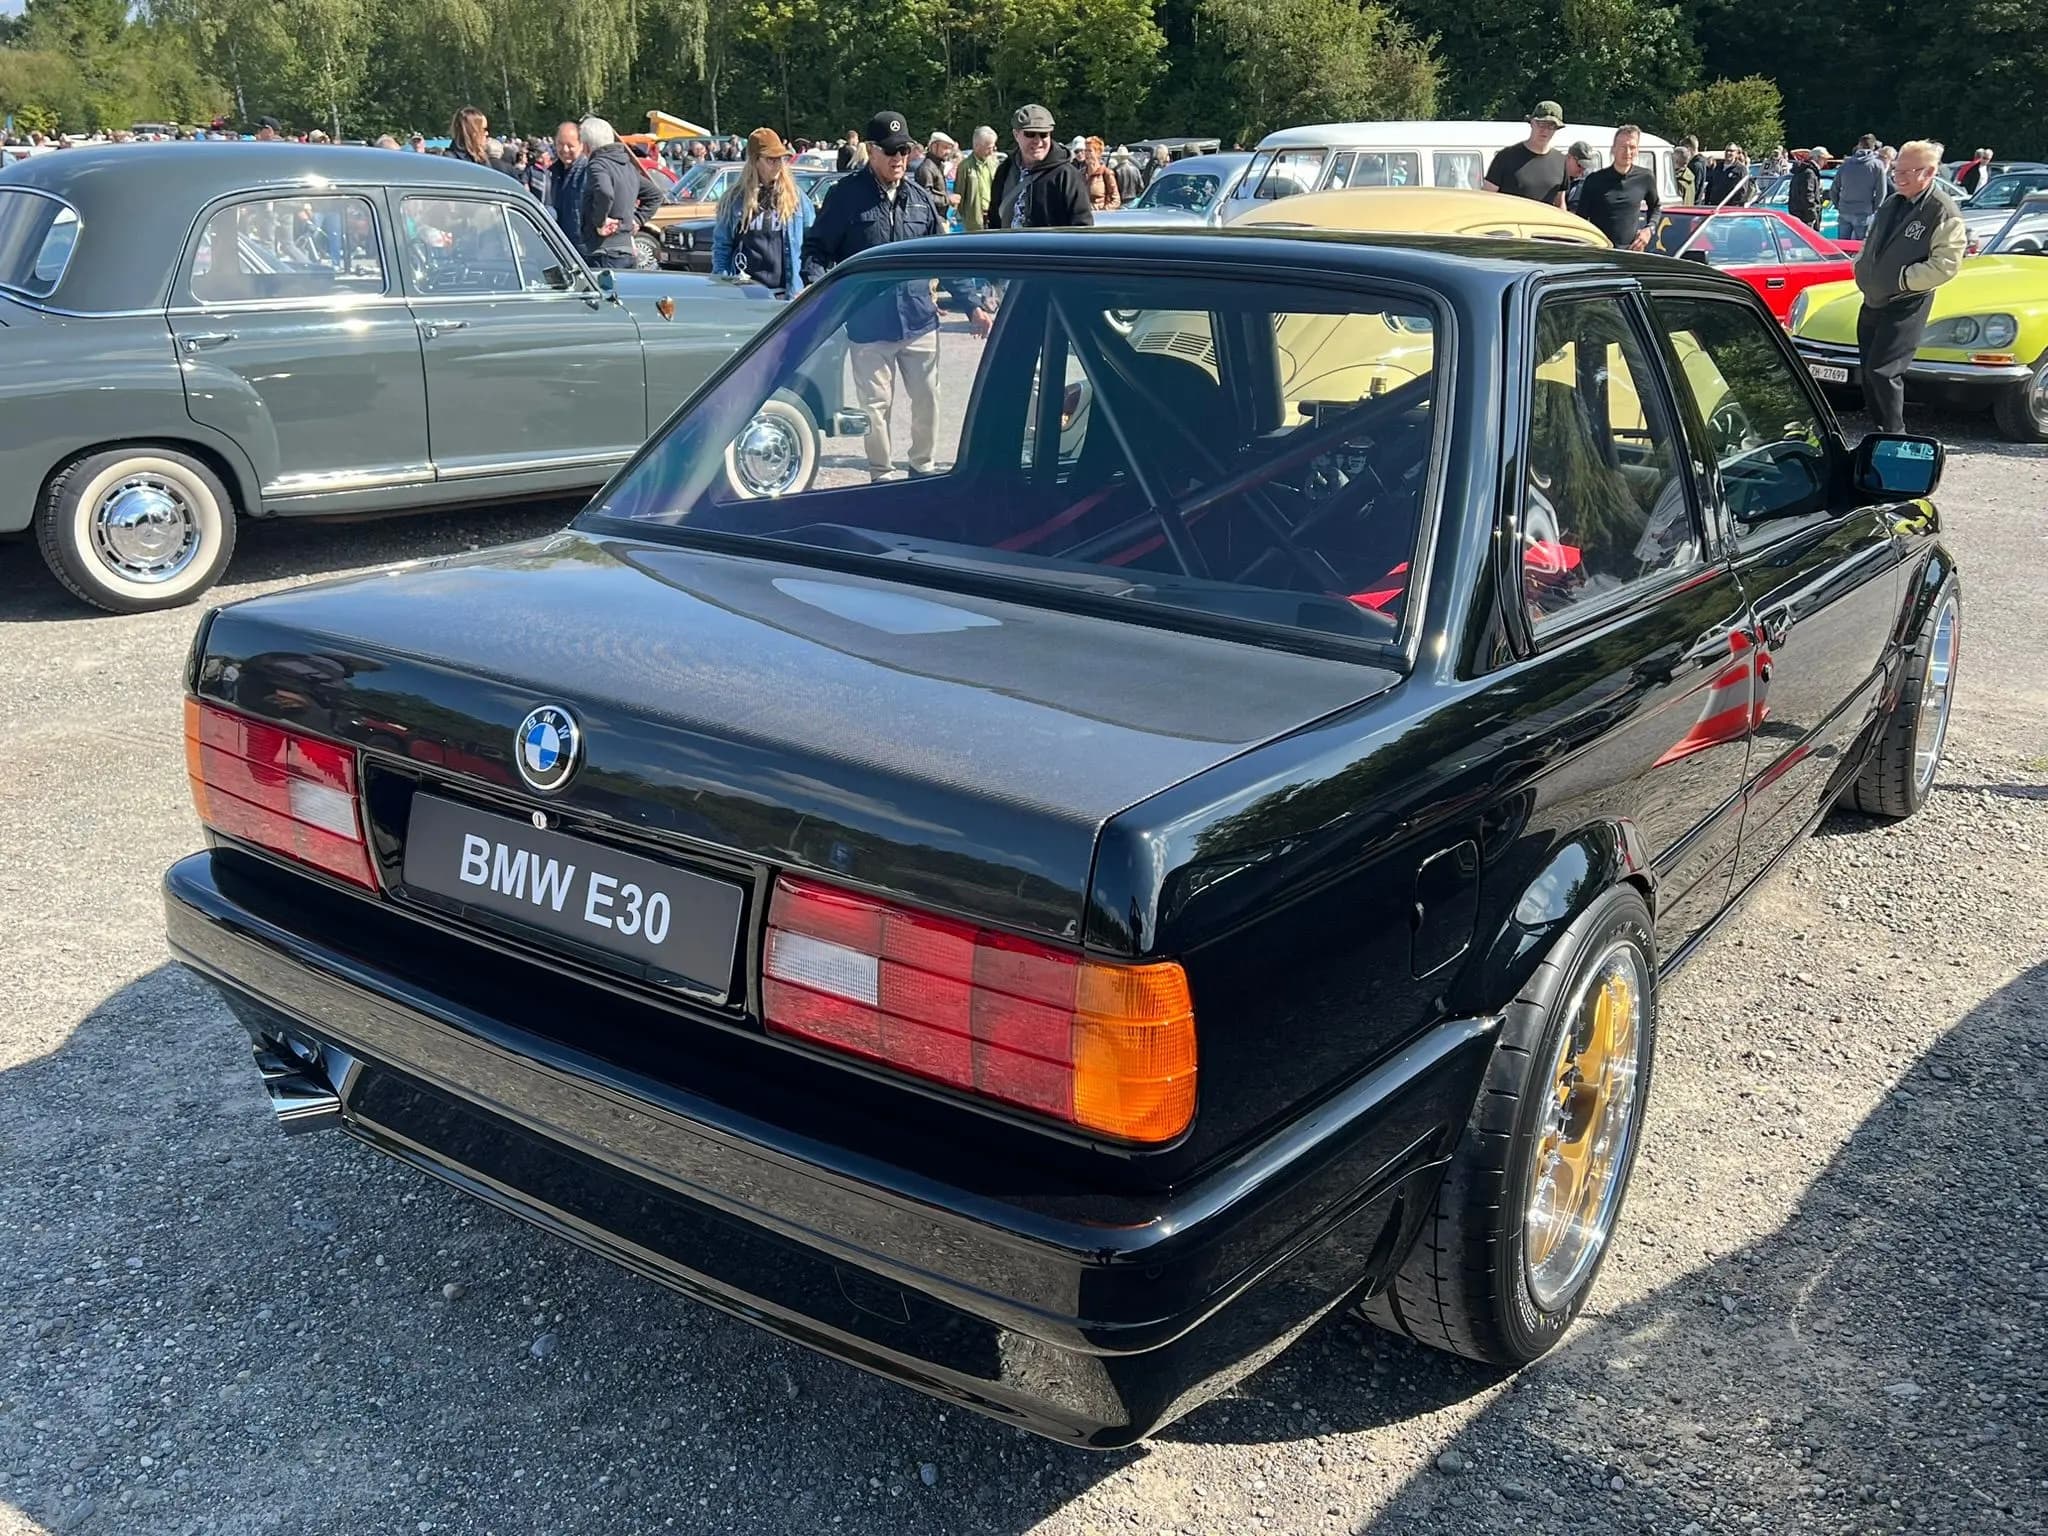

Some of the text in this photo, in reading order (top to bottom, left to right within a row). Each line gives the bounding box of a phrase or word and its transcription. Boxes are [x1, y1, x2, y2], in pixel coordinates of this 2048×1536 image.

[527, 711, 570, 740] BMW
[459, 833, 671, 945] BMW E30
